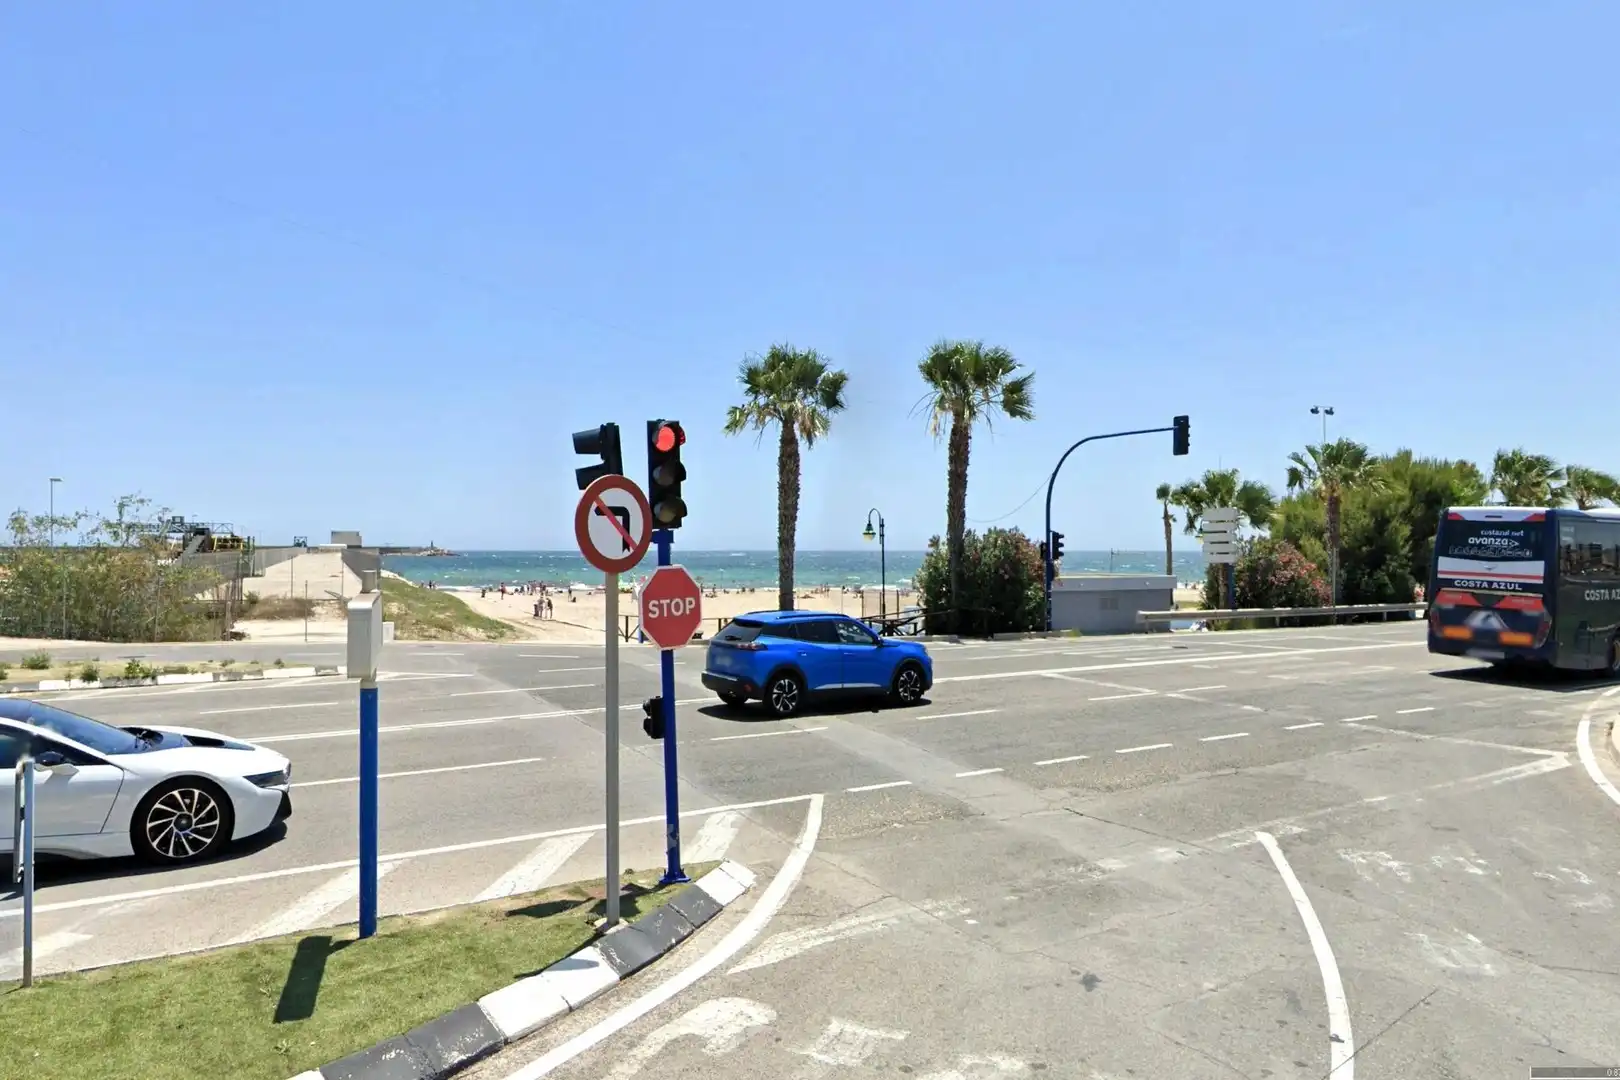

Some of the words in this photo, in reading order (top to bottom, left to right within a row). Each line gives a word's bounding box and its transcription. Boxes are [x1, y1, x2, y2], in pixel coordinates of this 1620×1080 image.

[1468, 536, 1508, 546] avanza
[1454, 579, 1489, 589] COSTA
[1491, 582, 1523, 591] AZUL
[1584, 589, 1609, 601] COSTA
[648, 597, 696, 618] STOP
